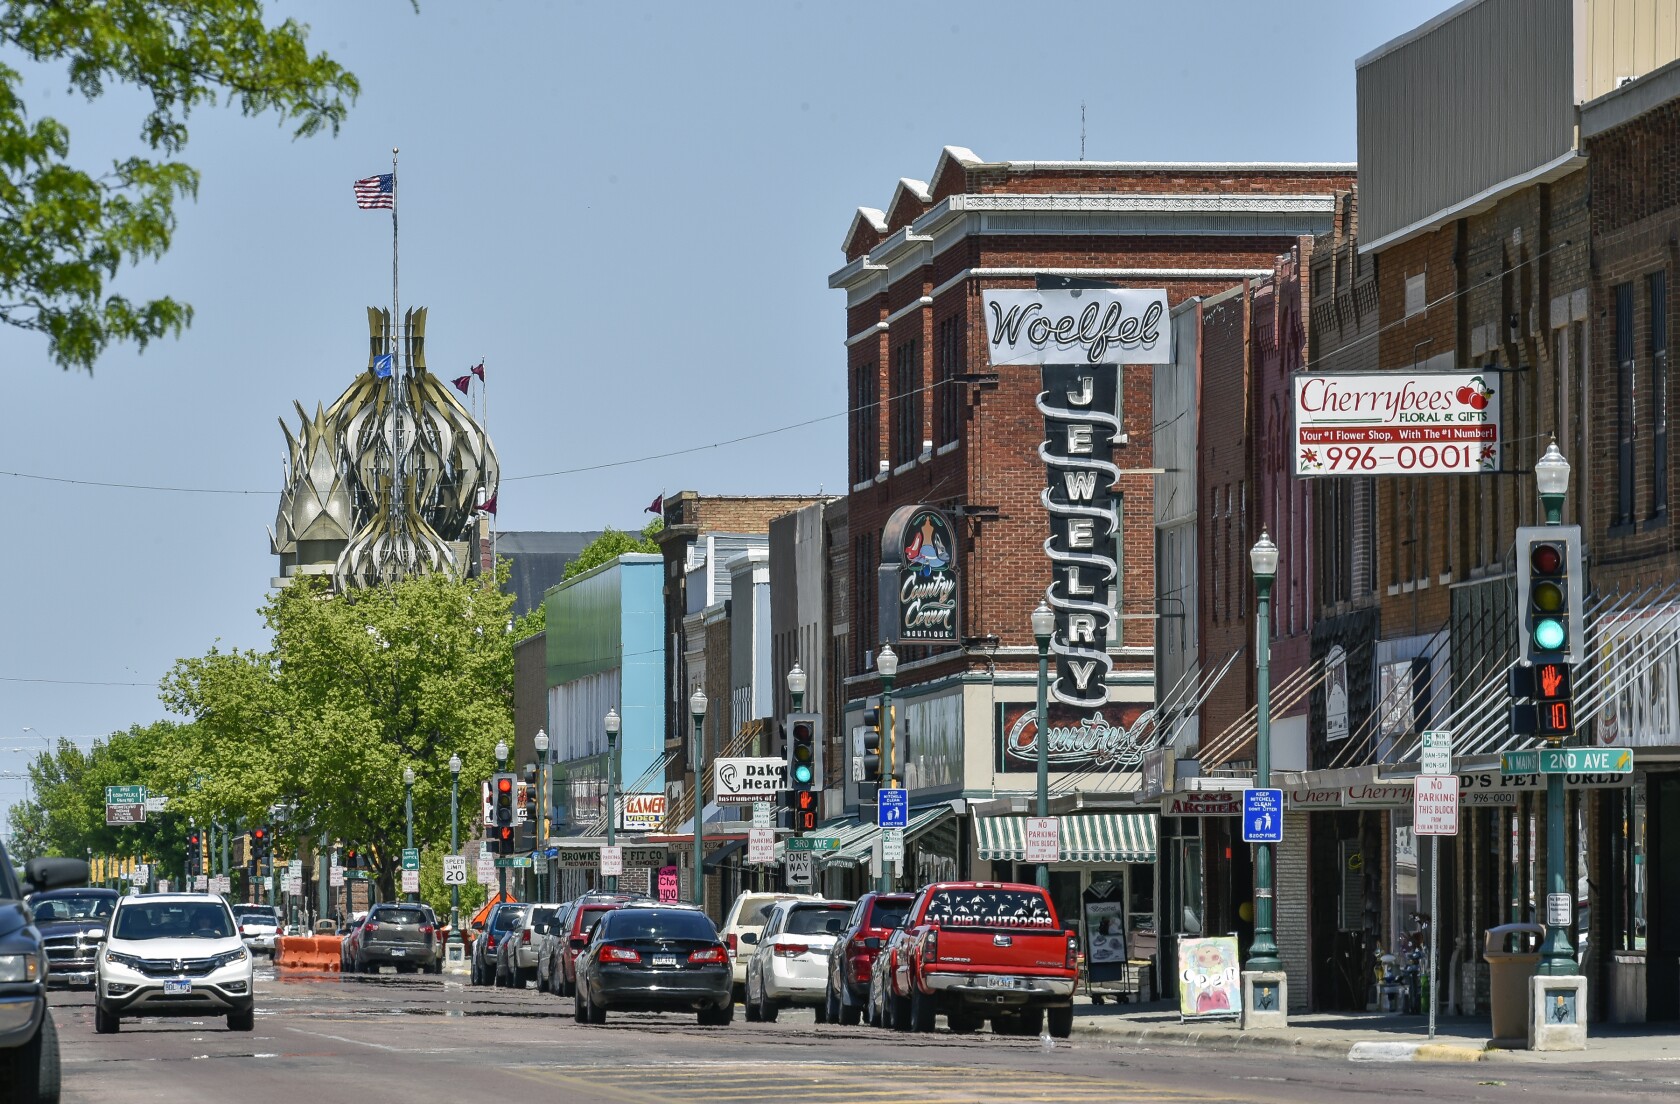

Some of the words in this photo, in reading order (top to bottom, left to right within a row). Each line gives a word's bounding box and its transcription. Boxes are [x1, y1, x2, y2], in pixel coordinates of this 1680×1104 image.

[989, 299, 1164, 362] Woelfel
[1300, 378, 1453, 422] Cherrybees
[1399, 412, 1440, 423] FLORAL
[1444, 414, 1454, 422] &
[1458, 411, 1488, 422] GIFTS
[1301, 431, 1323, 441] Your
[1324, 431, 1333, 440] #1
[1336, 430, 1365, 440] Flower
[1368, 430, 1393, 441] Shop,
[1399, 429, 1421, 439] With
[1424, 429, 1440, 439] The
[1441, 429, 1451, 438] #1
[1454, 428, 1493, 439] Number!
[1326, 445, 1470, 470] 996-0001
[1065, 376, 1099, 690] JEWELRY
[901, 571, 955, 604] Country
[905, 598, 955, 630] Corner
[906, 630, 950, 638] BOUTIQUE
[1551, 703, 1567, 729] 10
[1007, 709, 1124, 765] Cuntry
[1423, 734, 1431, 746] 15
[1508, 756, 1514, 770] N
[1515, 756, 1531, 770] MAIN
[1550, 753, 1576, 769] 2ND
[1583, 753, 1610, 769] AVE
[746, 764, 781, 776] Dako
[742, 777, 787, 789] Heari
[1430, 781, 1442, 790] NO
[1460, 773, 1492, 788] D'S
[1500, 773, 1541, 787] PET
[1566, 772, 1623, 785] ORLD
[1418, 793, 1455, 802] PARKING
[1473, 793, 1515, 803] 996-0001
[1419, 805, 1433, 814] THIS
[1434, 805, 1454, 814] BLOCK
[804, 811, 814, 828] 10
[1038, 821, 1047, 829] NO
[1028, 830, 1057, 838] PARKING
[794, 839, 809, 848] 3RD
[812, 839, 828, 848] AVE
[561, 850, 600, 861] BROWN'S
[630, 851, 646, 860] FIT
[649, 850, 664, 860] CO.
[789, 853, 808, 862] ONE
[513, 858, 523, 866] AVE
[789, 863, 809, 872] WAY
[446, 870, 464, 881] 20
[924, 914, 949, 926] EAT
[952, 914, 981, 926] DIRT
[984, 915, 1053, 928] OUTDOORS
